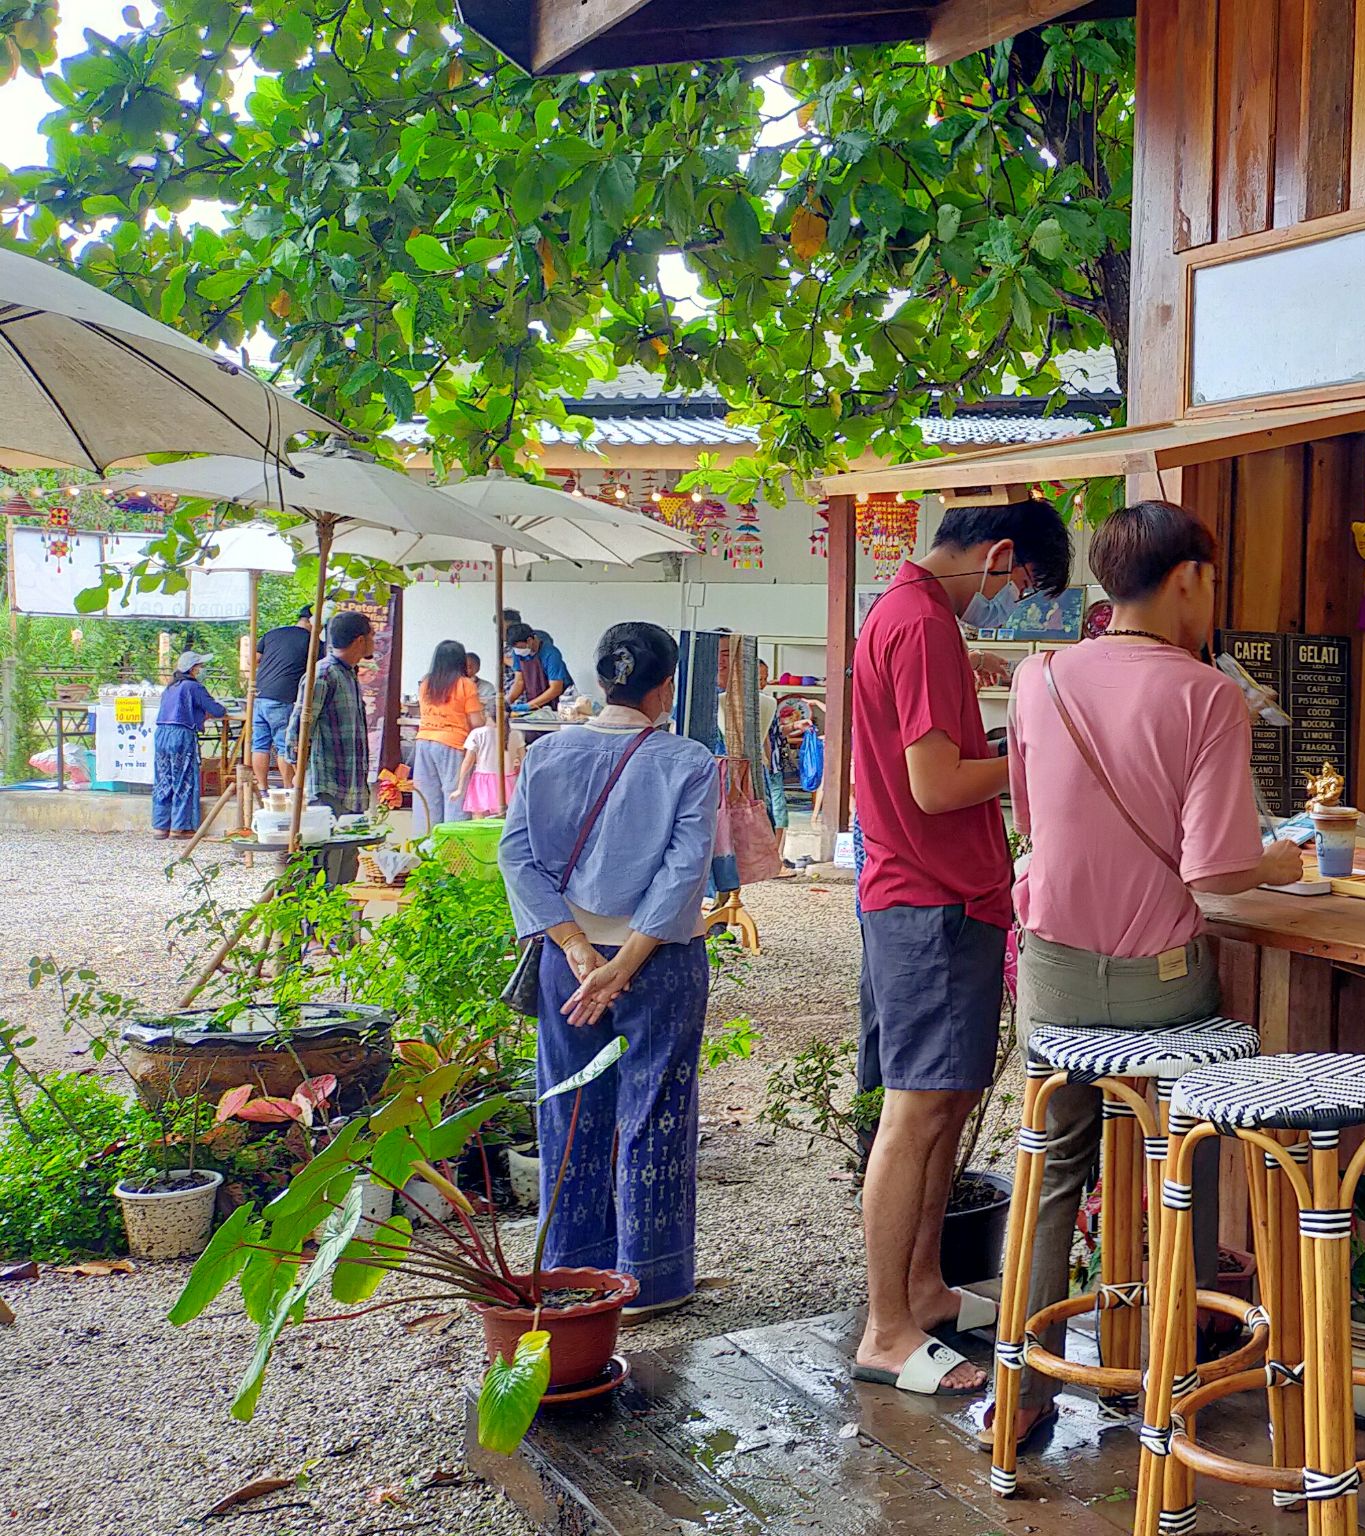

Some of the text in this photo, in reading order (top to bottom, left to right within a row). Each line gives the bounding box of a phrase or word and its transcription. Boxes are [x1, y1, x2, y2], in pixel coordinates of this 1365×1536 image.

[1299, 645, 1339, 665] GELATI
[1296, 674, 1342, 683] CIOCCOLATO
[1298, 697, 1340, 706] PISTACCHIO
[1307, 708, 1331, 717] COCCO
[1301, 720, 1336, 729] NOCCIOLA
[1303, 732, 1333, 740] LIMONE
[1254, 742, 1275, 750] LUNGO
[1301, 743, 1336, 751] FRAGOLA
